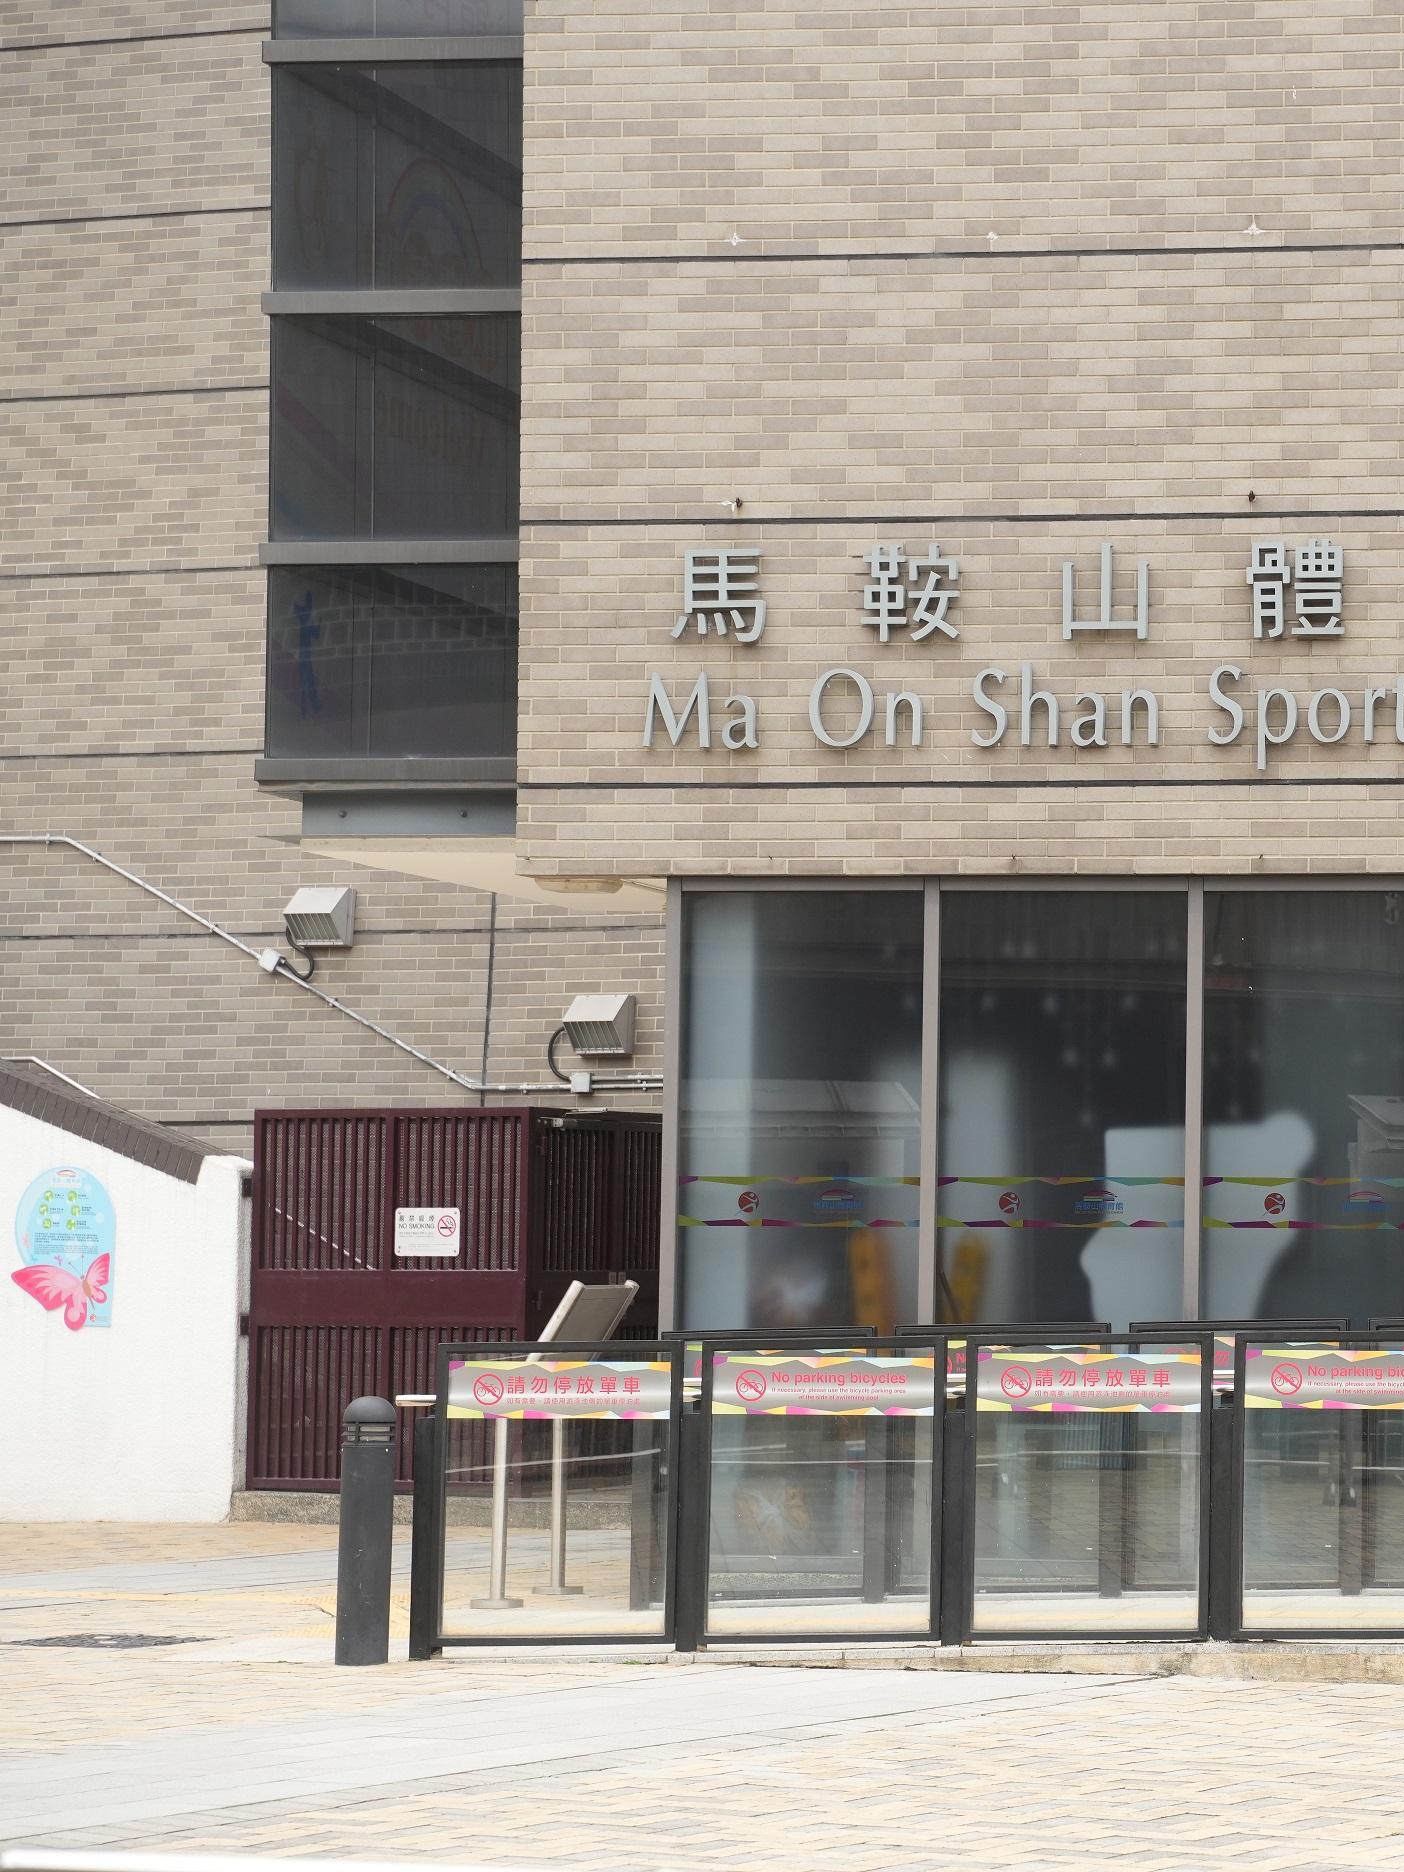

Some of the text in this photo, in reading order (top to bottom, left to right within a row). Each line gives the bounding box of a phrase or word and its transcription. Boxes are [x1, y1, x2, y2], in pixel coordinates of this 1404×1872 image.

[643, 671, 760, 750] Ma
[808, 668, 924, 749] On
[971, 662, 1160, 749] Shan
[772, 1372, 906, 1386] No parking bicycles
[1035, 1369, 1171, 1387] 請勿停放單車
[1308, 1366, 1326, 1377] No
[1331, 1366, 1383, 1380] parking
[507, 1376, 641, 1395] 請勿停放單車
